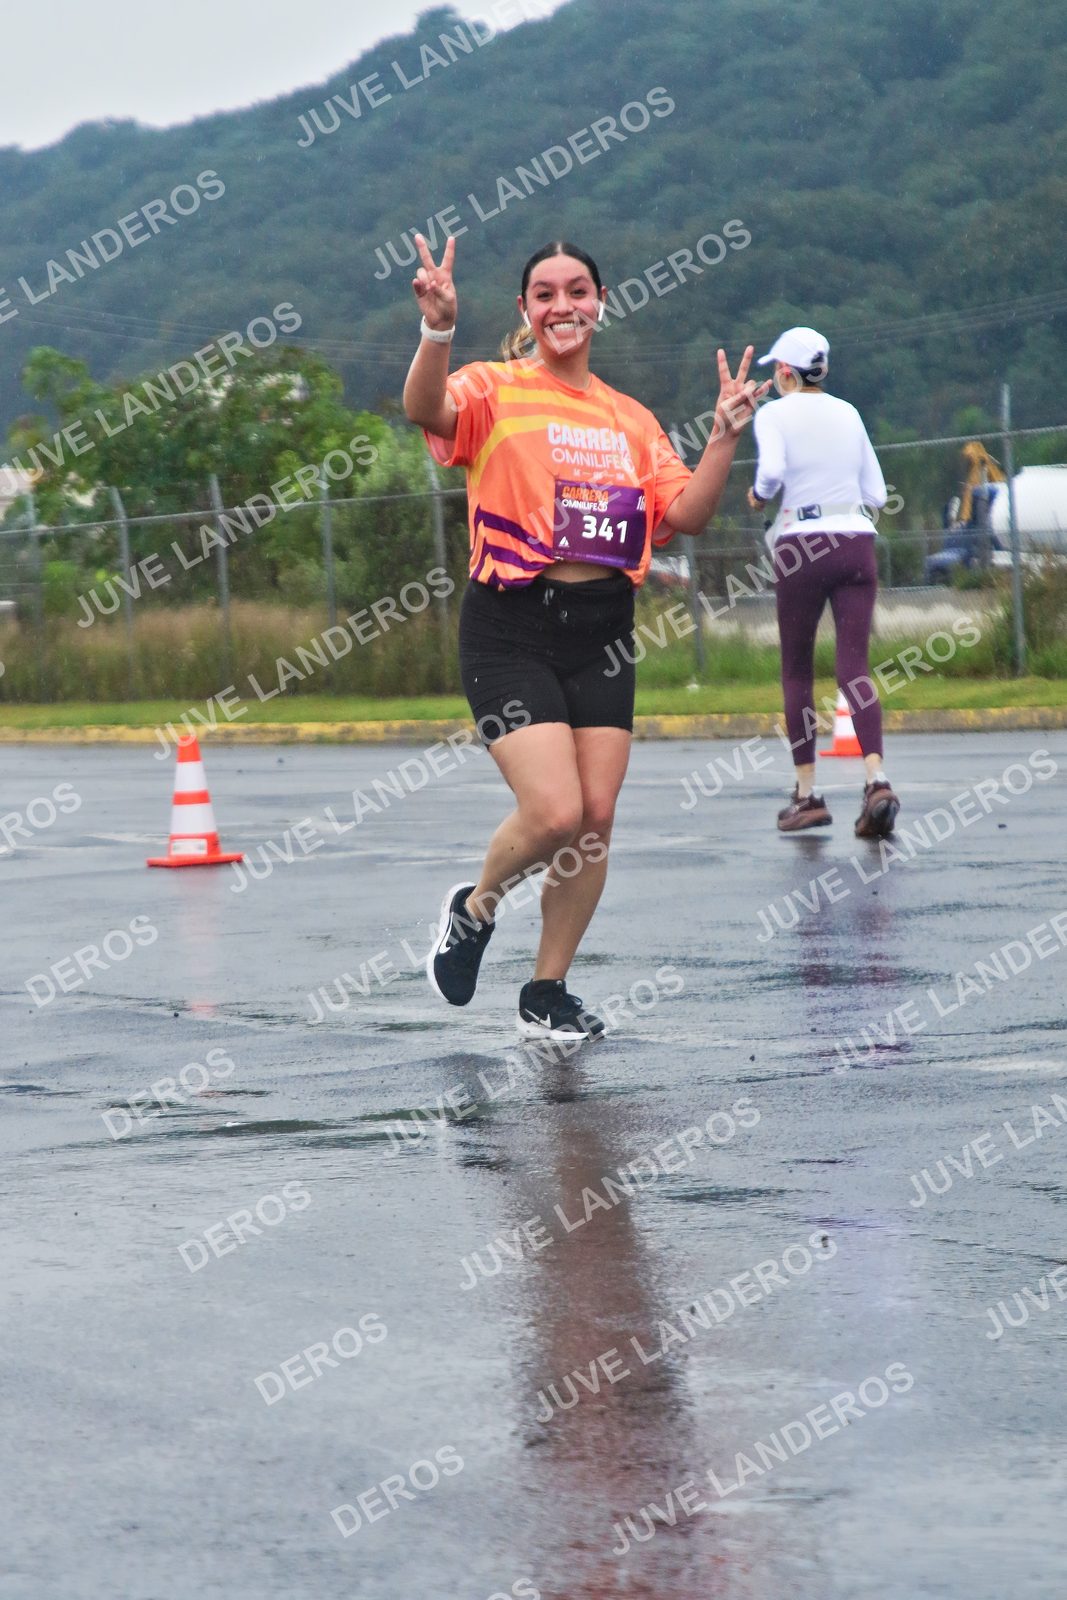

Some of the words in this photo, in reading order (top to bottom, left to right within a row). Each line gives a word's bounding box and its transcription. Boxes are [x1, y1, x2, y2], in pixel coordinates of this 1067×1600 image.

[551, 447, 622, 470] OMNILIFE
[561, 485, 609, 503] CARRERA
[581, 514, 628, 544] 341
